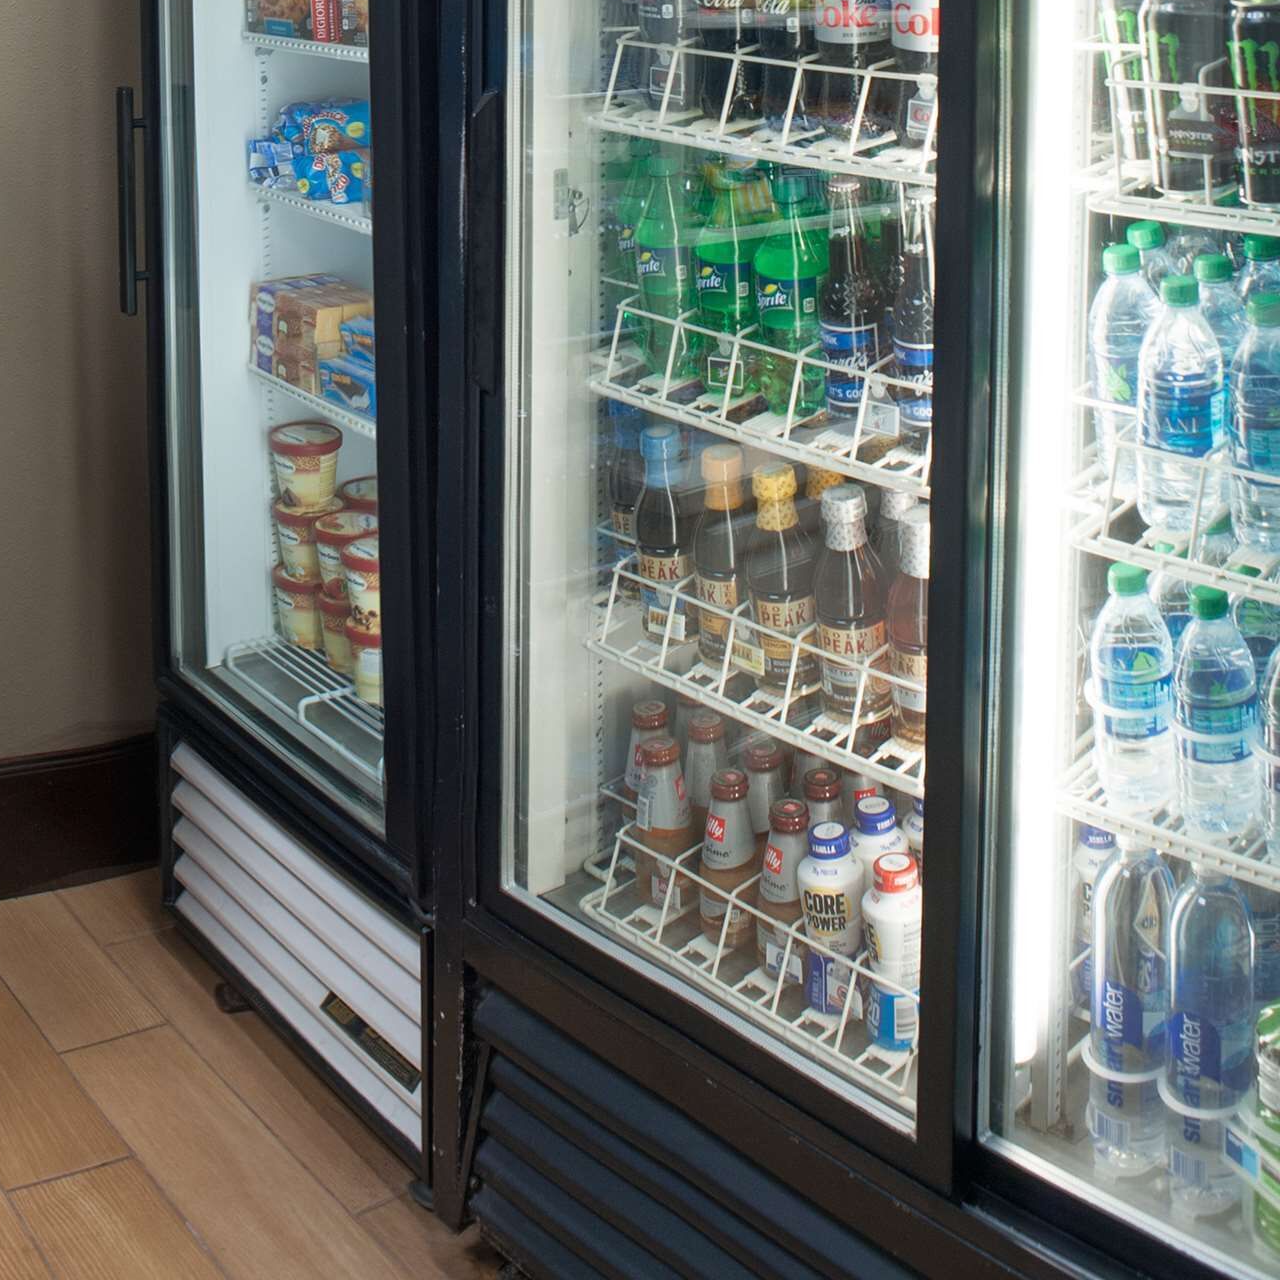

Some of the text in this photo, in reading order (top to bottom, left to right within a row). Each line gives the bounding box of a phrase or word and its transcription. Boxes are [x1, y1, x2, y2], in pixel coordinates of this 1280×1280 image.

[1169, 129, 1215, 141] MONSTER
[761, 609, 808, 628] PEAK
[824, 638, 866, 654] PEAK
[804, 890, 845, 916] CORE
[805, 914, 846, 932] POWER
